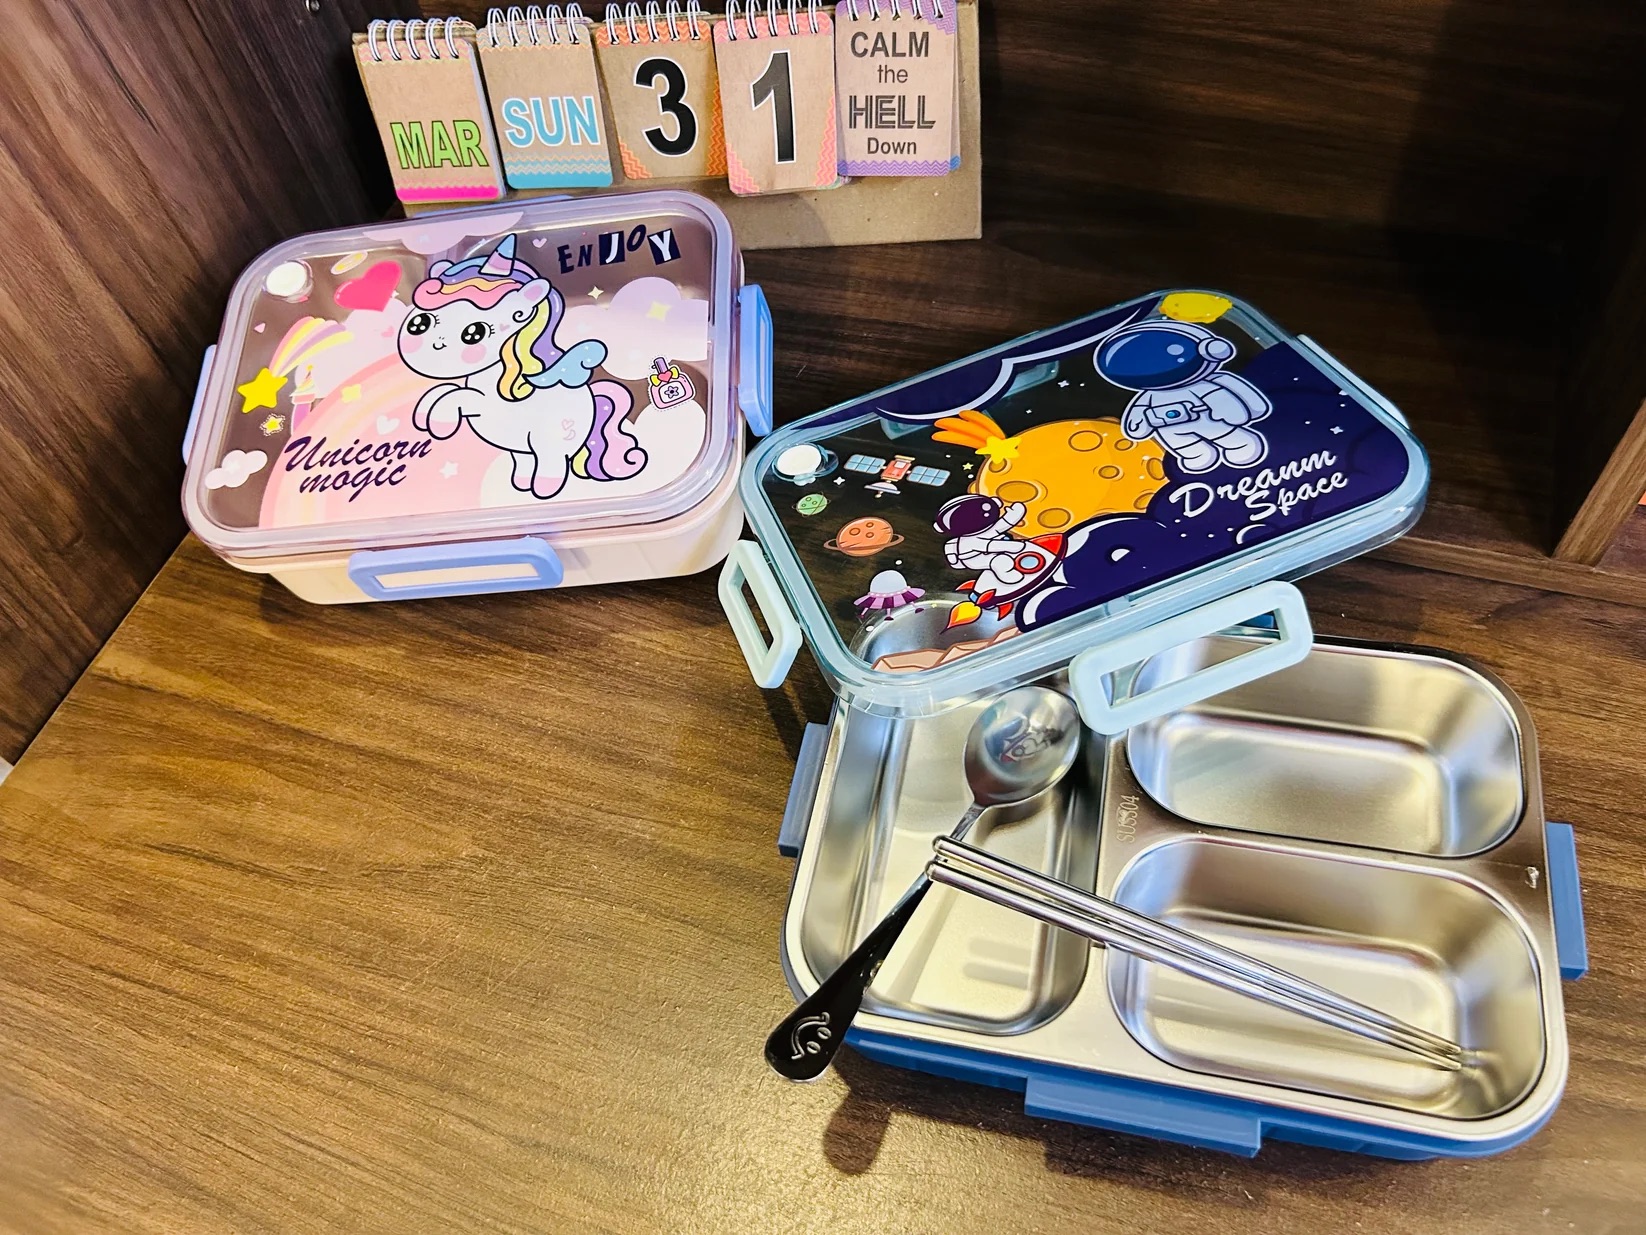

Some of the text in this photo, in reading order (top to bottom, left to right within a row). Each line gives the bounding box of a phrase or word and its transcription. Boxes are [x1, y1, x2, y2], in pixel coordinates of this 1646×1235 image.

[850, 31, 930, 58] CALM
[877, 64, 908, 84] the
[501, 96, 601, 148] SUN
[848, 95, 937, 130] HELL
[389, 119, 490, 170] MAR
[867, 137, 918, 155] Down
[557, 224, 681, 275] ENJOY
[284, 436, 432, 472] Unicorn
[1245, 472, 1349, 521] Space
